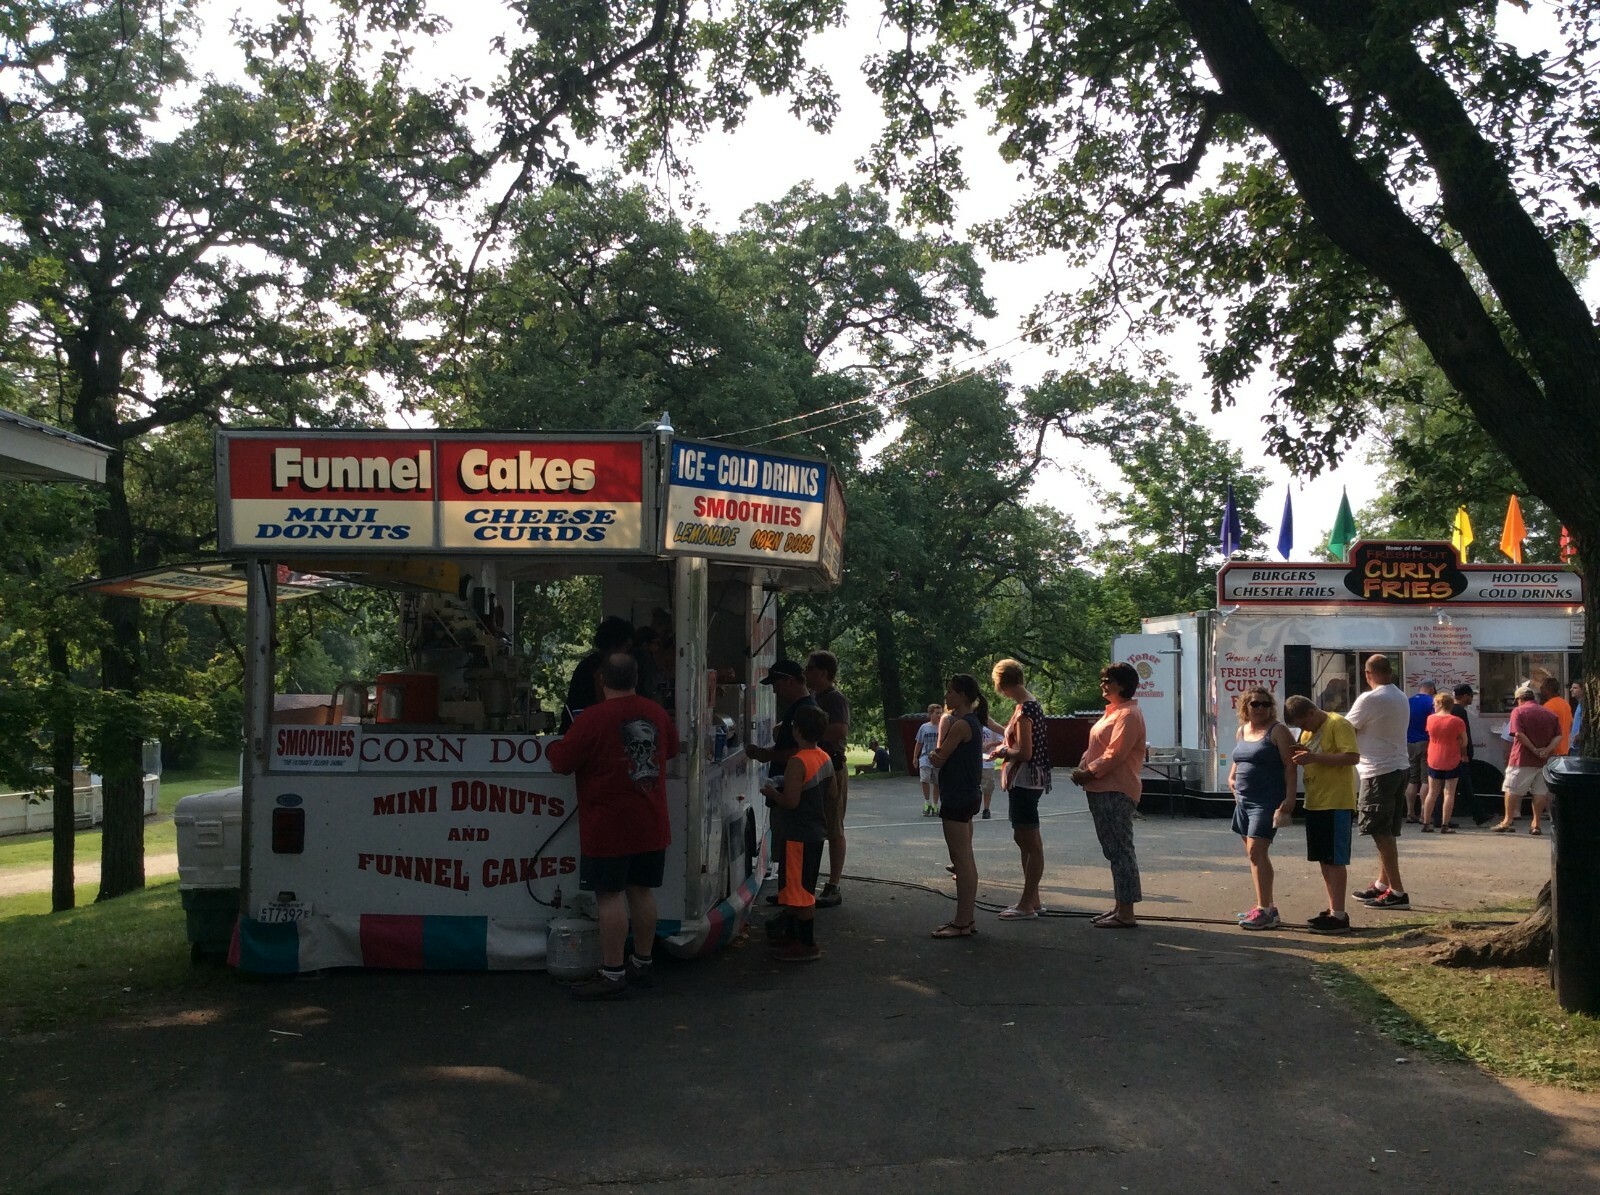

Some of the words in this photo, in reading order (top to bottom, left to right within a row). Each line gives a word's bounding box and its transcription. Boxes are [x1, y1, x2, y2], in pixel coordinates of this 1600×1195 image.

[274, 447, 431, 490] Funnel
[459, 448, 596, 492] Cakes
[762, 461, 819, 497] DRINKS
[284, 508, 379, 522] MINI
[464, 509, 617, 524] CHEESE
[693, 495, 802, 527] SMOOTHIES
[255, 525, 411, 540] DONUTS
[473, 527, 606, 541] CURDS
[673, 521, 741, 547] LEMONADE
[749, 529, 783, 552] CORN
[783, 533, 815, 554] DOGS
[1252, 571, 1316, 581] BURGERS
[1364, 559, 1447, 579] CURLY
[1492, 573, 1559, 583] HOTDOGS
[1232, 587, 1293, 597] CHESTER
[1299, 587, 1336, 597] FRIES
[1363, 578, 1453, 599] FRIES
[1479, 589, 1517, 599] COLD
[1521, 589, 1573, 599] DRINKS
[1225, 653, 1249, 662] Home
[1254, 654, 1262, 664] of
[1265, 654, 1278, 662] the
[1220, 668, 1257, 678] FRESH
[1260, 668, 1283, 679] CUT
[276, 729, 355, 757] SMOOTHIES
[359, 738, 467, 763] CORN
[373, 785, 438, 816] MINI
[451, 780, 565, 818] DONUTS
[448, 828, 489, 841] AND
[358, 853, 470, 892] FUNNEL
[482, 857, 576, 888] CAKES
